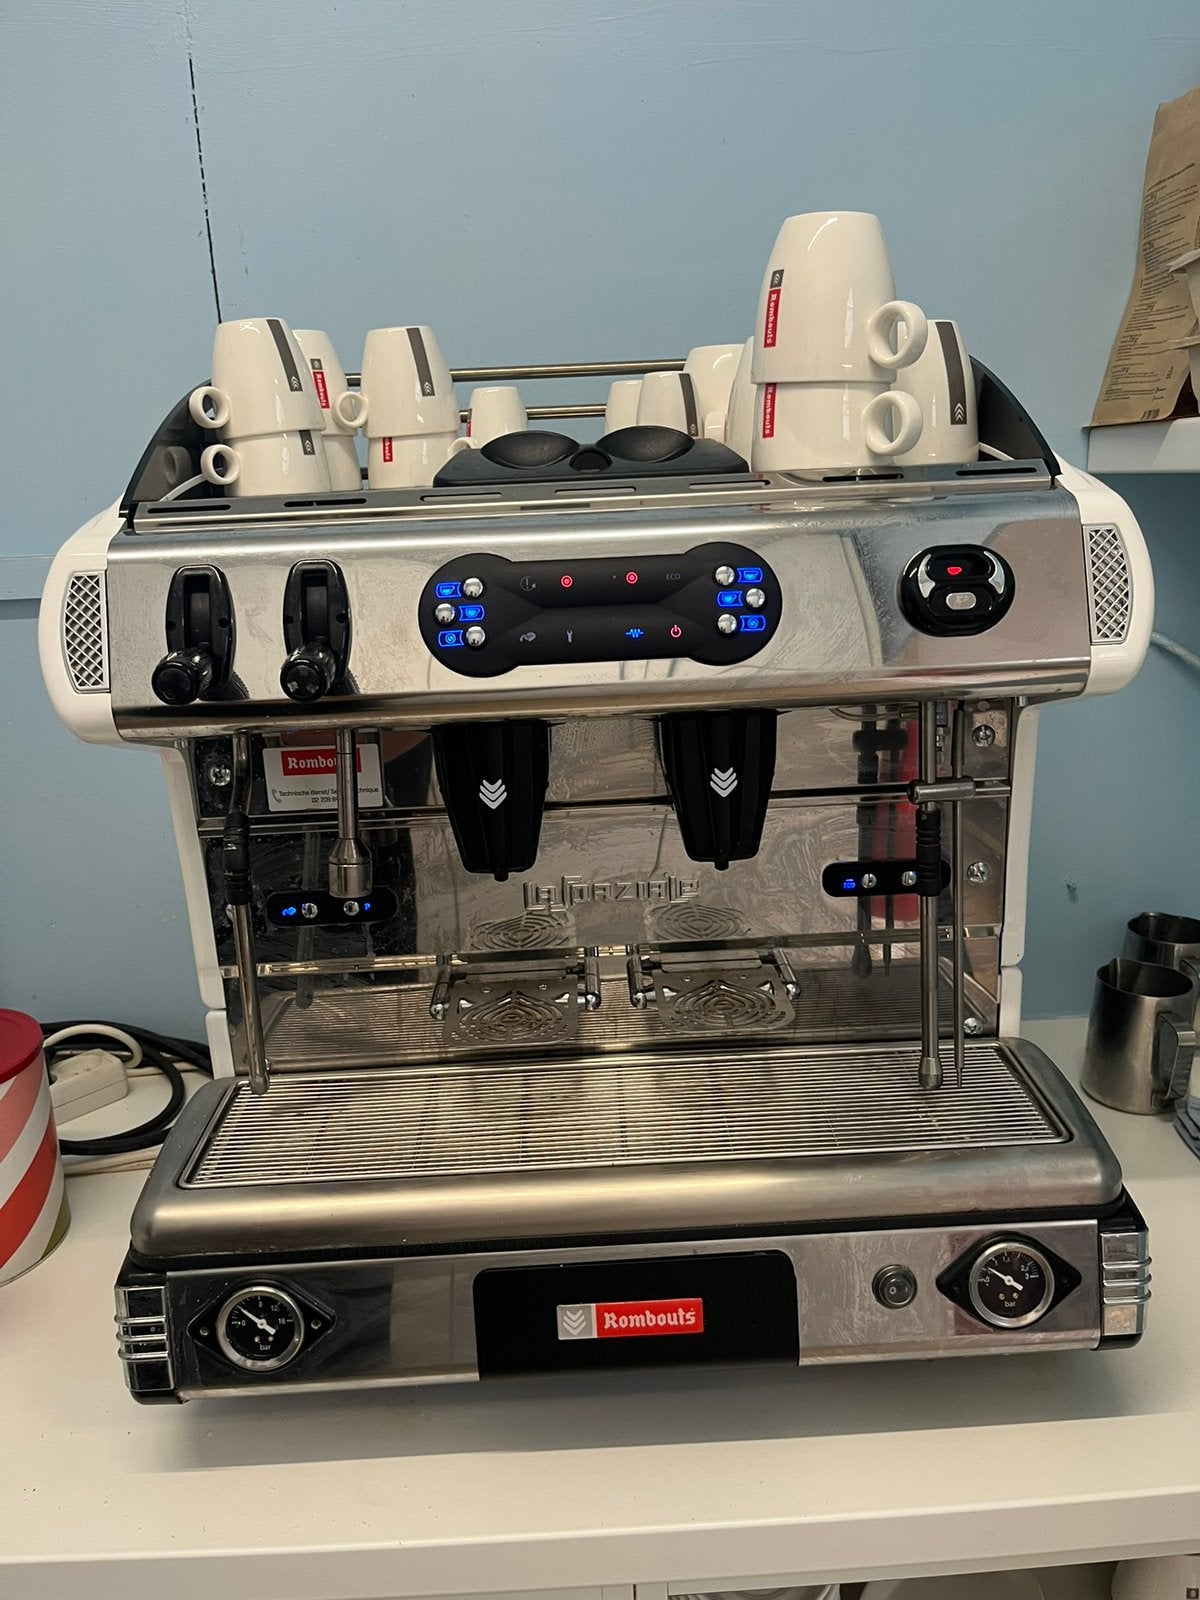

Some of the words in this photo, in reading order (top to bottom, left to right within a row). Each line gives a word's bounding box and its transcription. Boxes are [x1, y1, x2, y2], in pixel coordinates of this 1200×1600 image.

[766, 293, 777, 344] Rombouts
[241, 1319, 246, 1327] 0
[603, 1307, 696, 1330] Rombouts
